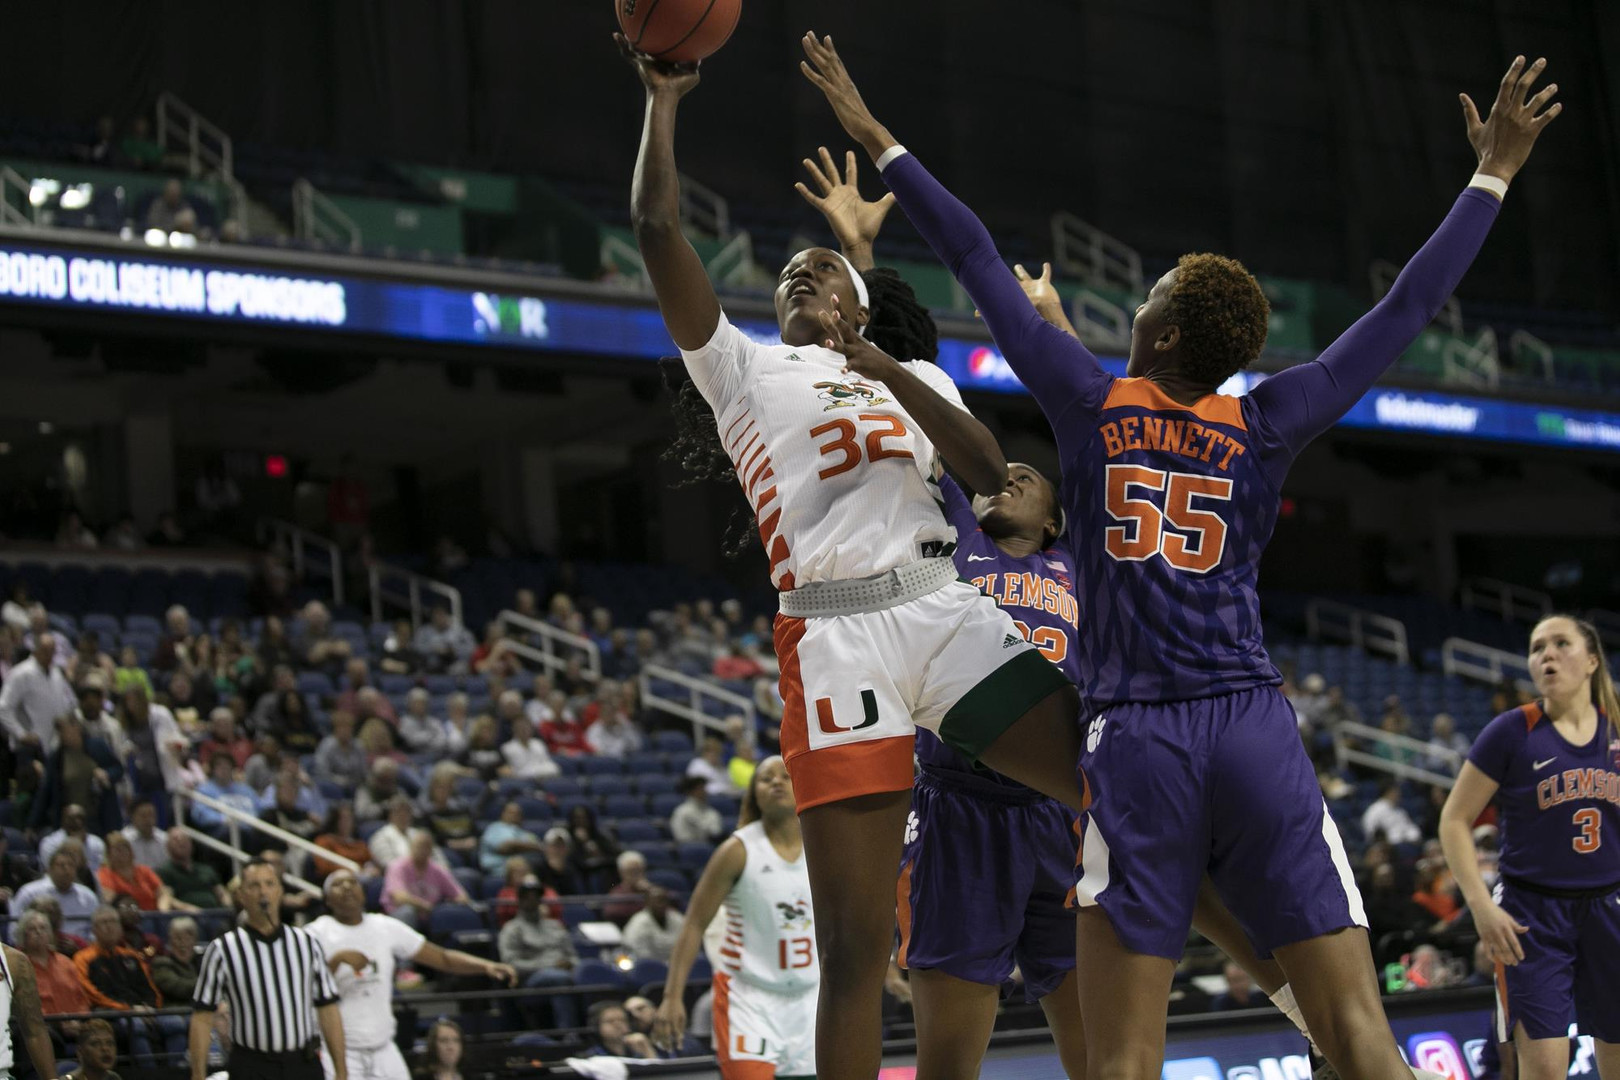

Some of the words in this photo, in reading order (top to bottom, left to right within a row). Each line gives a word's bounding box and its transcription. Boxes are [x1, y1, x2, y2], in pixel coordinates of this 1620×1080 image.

[69, 258, 205, 313] COLISEUM
[206, 271, 346, 325] SPONSORS
[809, 414, 914, 481] 32
[1100, 416, 1246, 471] BENNETT
[1105, 464, 1234, 574] 55
[815, 688, 880, 734] U
[1572, 807, 1602, 854] 3
[778, 937, 813, 970] 13
[735, 1034, 767, 1056] U
